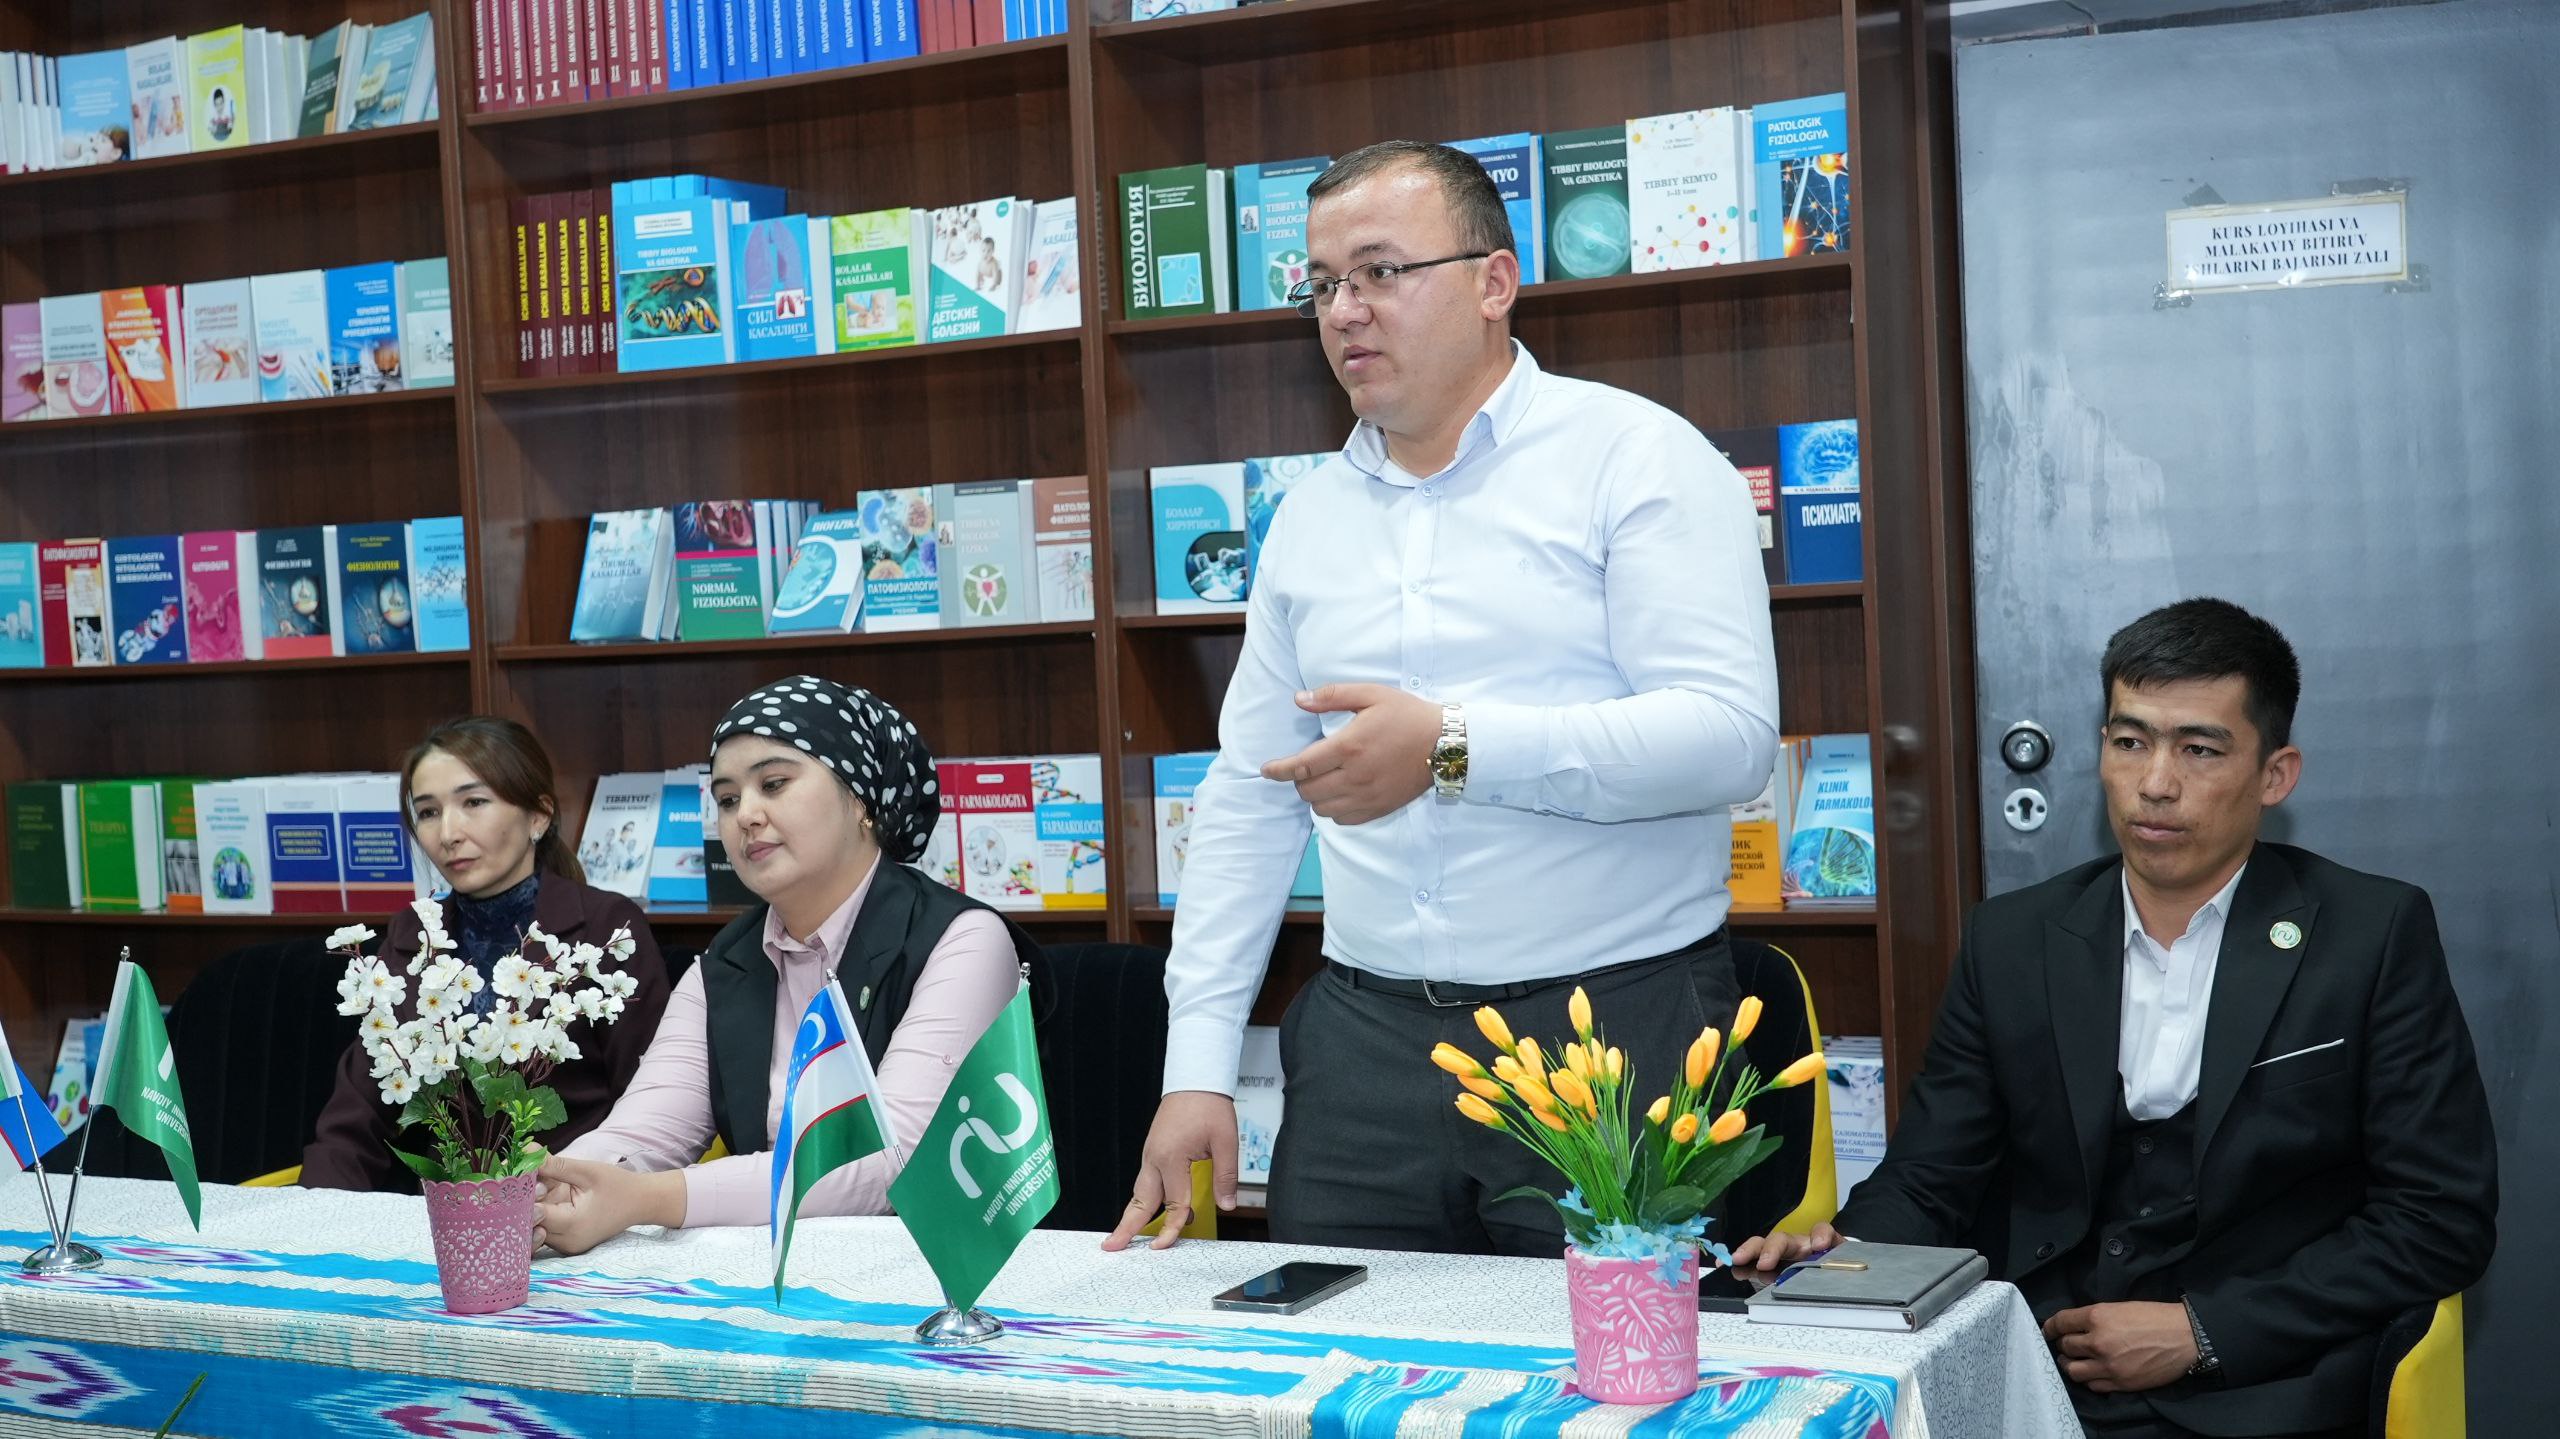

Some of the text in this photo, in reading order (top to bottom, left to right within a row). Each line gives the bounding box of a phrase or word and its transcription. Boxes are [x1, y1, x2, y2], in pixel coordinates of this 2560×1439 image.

[610, 27, 618, 58] KLINIK
[671, 10, 681, 72] ПАТОЛОГИЧЕСКАЯ
[697, 5, 708, 68] ПАТОЛОГИЧЕСКАЯ
[725, 2, 735, 66] ПАТОЛОГИЧЕСКАЯ
[568, 32, 576, 62] KLINIK
[590, 30, 598, 60] KLINIK
[630, 31, 638, 62] KLINIK
[651, 29, 659, 60] KLINIK
[478, 49, 486, 79] KLINIK
[494, 46, 502, 76] KLINIK
[514, 50, 522, 79] KLINIK
[534, 46, 542, 76] KLINIK
[550, 42, 558, 72] KLINIK
[1768, 116, 1821, 133] PATOLOGIK
[1768, 130, 1829, 147] FIZIOLOGIYA
[1486, 167, 1519, 184] MYO
[1551, 159, 1628, 175] TIBBIY BIOLOGIY
[1561, 172, 1622, 186] VA GENETIKA
[1643, 173, 1718, 190] TIBBIY KIMYO
[1265, 201, 1296, 213] TIBBIY
[1266, 214, 1308, 227] BIOLOGI
[2212, 216, 2360, 240] KURS LOYIHASI VA
[1266, 229, 1298, 240] FIZIKA
[661, 245, 698, 257] BIOLOGIYA
[1128, 185, 1149, 309] БИОЛОГИЯ
[2205, 233, 2368, 258] MALAKAVIY BITIRUV
[658, 256, 690, 267] GENETIKA
[835, 263, 872, 276] BOLALAR
[2272, 253, 2348, 271] BAJARISH
[2354, 250, 2389, 264] ZALI
[748, 310, 774, 325] СИЛ
[932, 306, 978, 326] ДЕТСКИЕ
[749, 322, 808, 340] КАСАЛЛИГИ
[932, 321, 980, 338] БОЛЕЗНИ
[265, 558, 312, 570] ФИЗИОЛОГИЯ
[346, 560, 400, 572] ФИЗИОЛОГИЯ
[692, 582, 738, 595] NORMAL
[693, 594, 758, 609] FIZIOLOGIYA
[1817, 780, 1849, 793] KLINIK
[959, 794, 1027, 809] FARMAKOLOGIYA
[140, 1086, 172, 1109] NAVOIY
[982, 1191, 1006, 1226] NAVOIY
